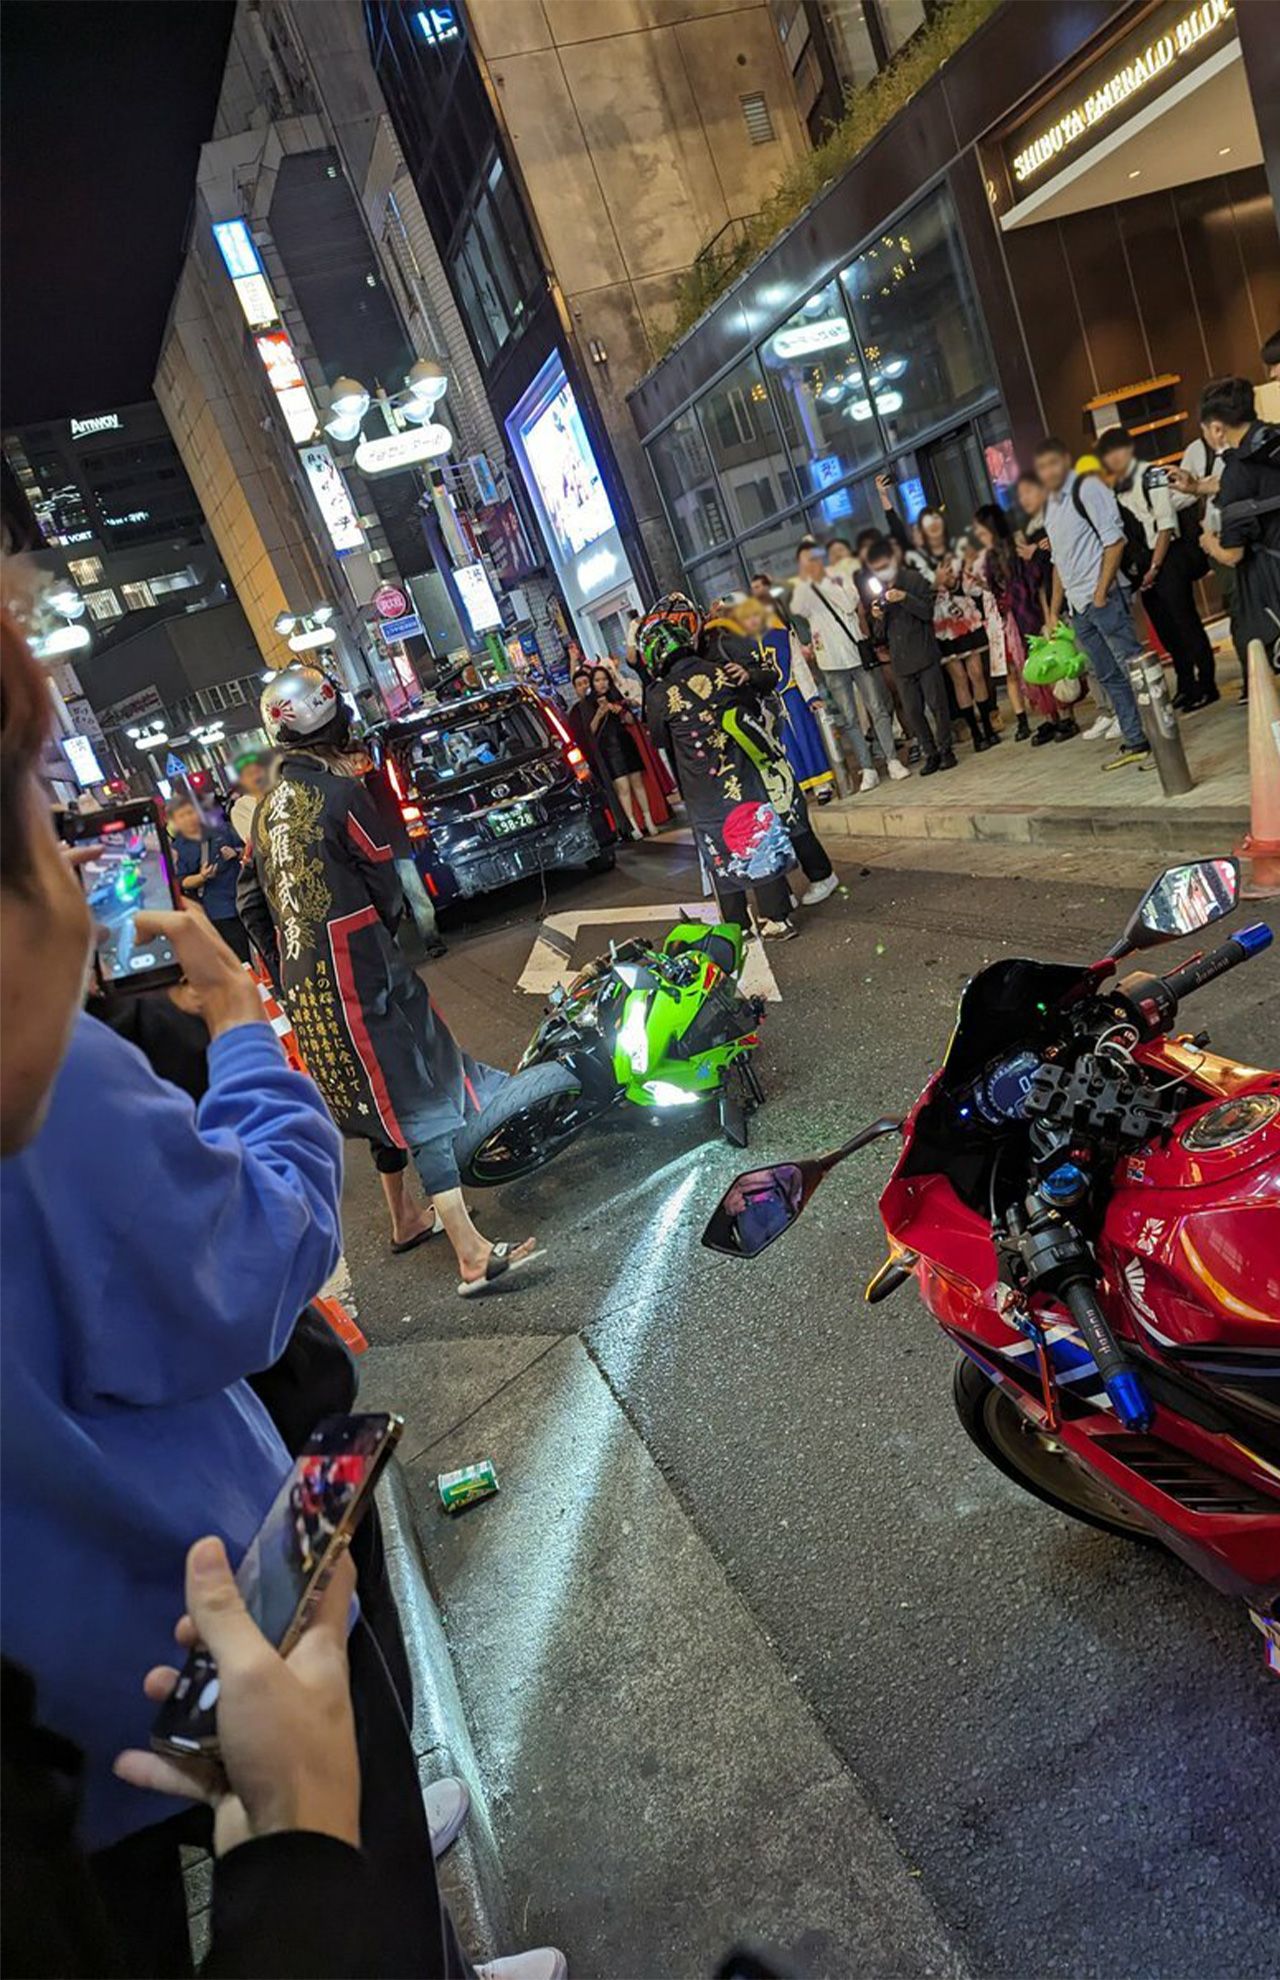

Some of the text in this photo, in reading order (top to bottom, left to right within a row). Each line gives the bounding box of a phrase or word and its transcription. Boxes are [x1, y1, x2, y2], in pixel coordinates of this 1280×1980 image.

[1013, 109, 1086, 182] SHIBUYA
[1083, 36, 1174, 127] EMERALD
[71, 413, 121, 437] Amway
[500, 813, 534, 833] 98-28
[268, 779, 300, 961] 愛羅武勇
